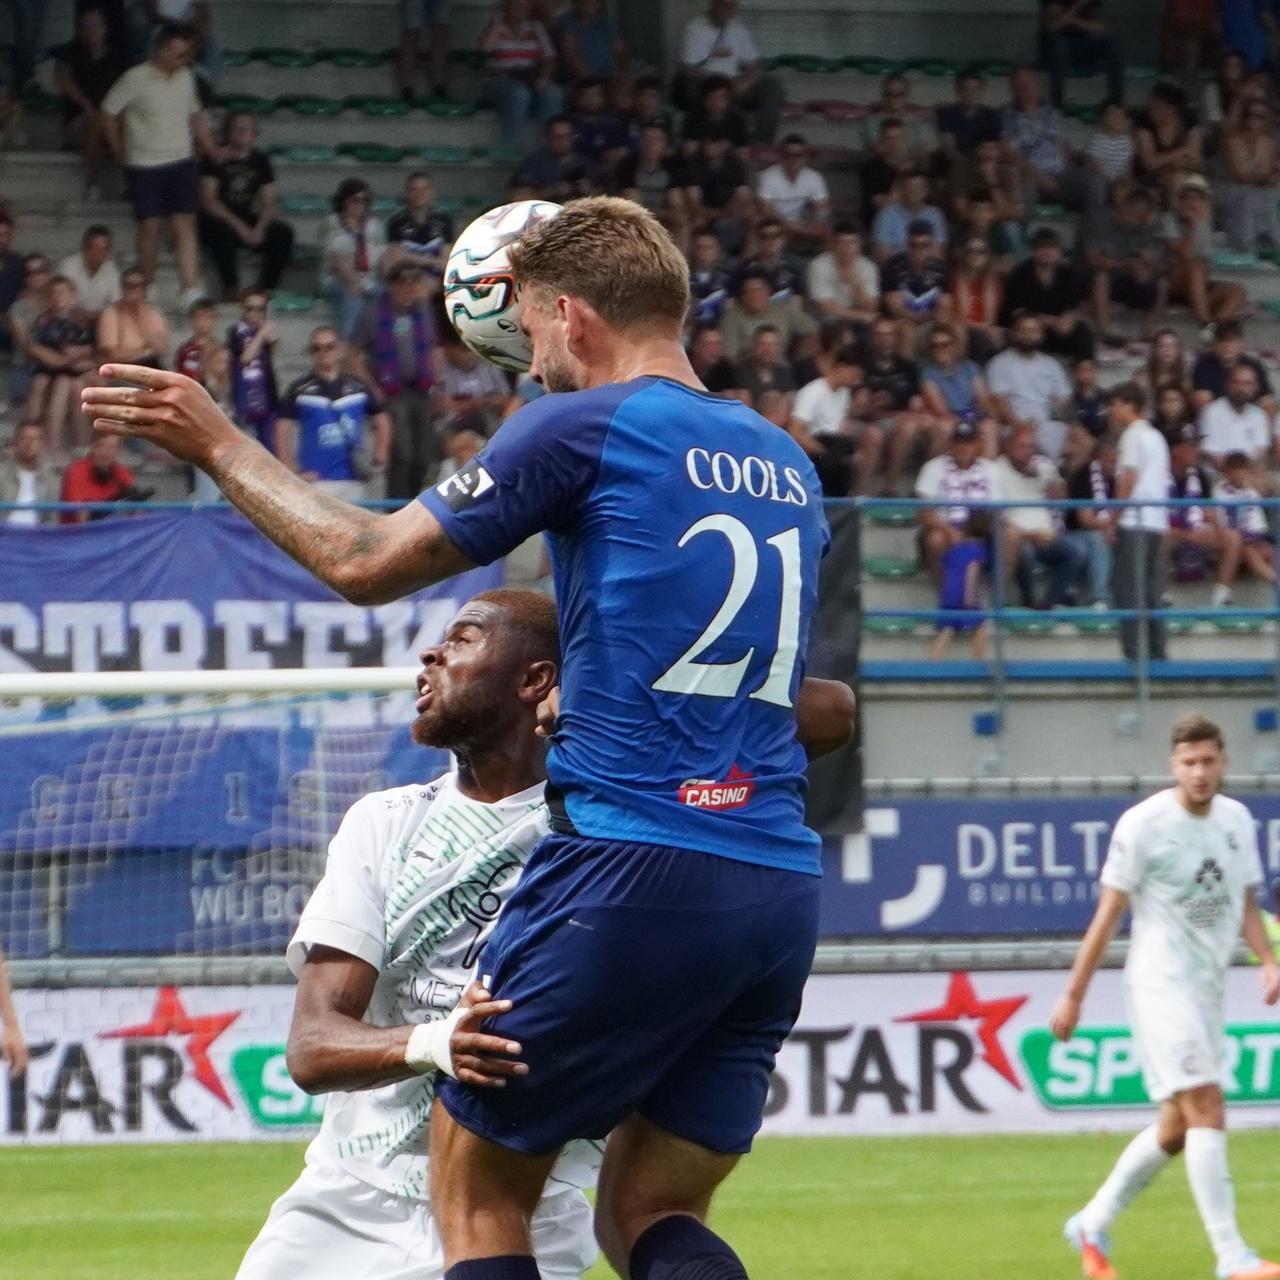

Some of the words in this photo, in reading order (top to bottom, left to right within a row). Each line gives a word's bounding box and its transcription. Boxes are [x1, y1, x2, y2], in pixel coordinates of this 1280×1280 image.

[686, 447, 808, 506] COOLS
[651, 513, 803, 708] 21
[685, 787, 748, 807] CASINO
[958, 820, 1112, 880] DELT
